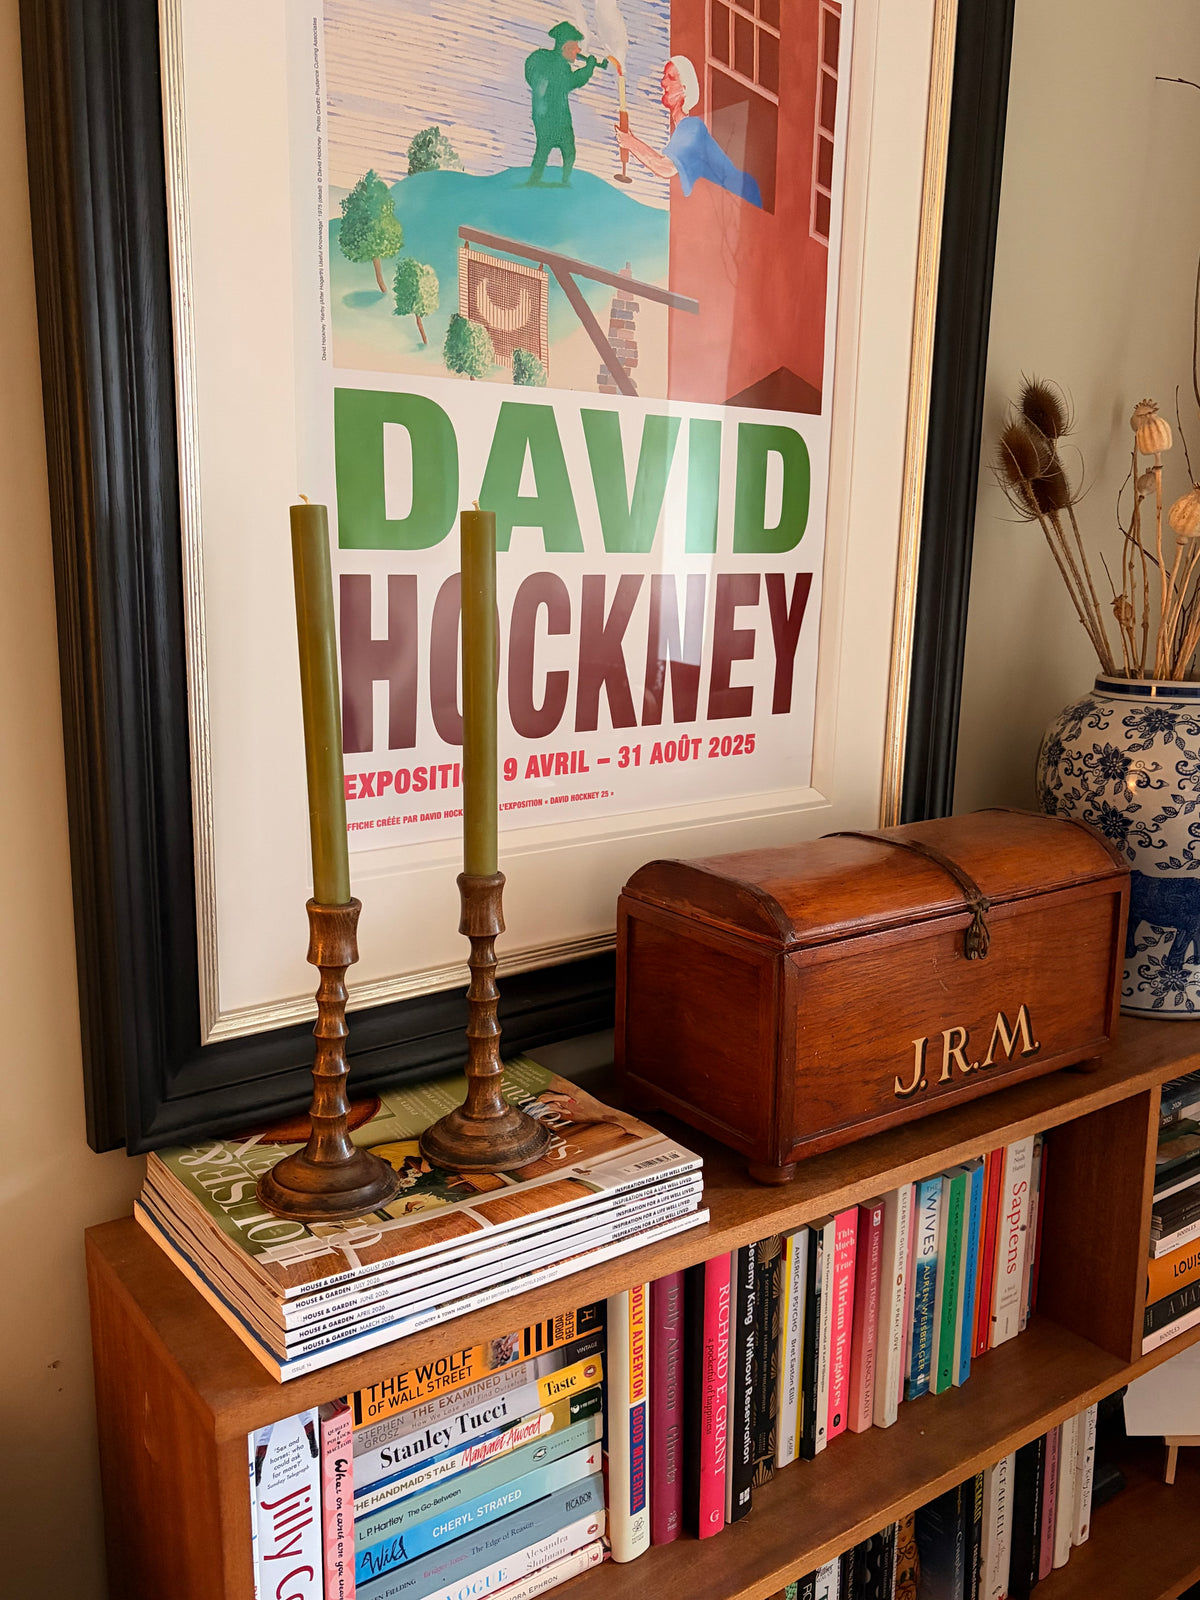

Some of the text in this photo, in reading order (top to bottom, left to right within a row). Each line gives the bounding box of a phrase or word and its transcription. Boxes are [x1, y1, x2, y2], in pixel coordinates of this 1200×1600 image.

[334, 386, 811, 555] DAVID
[339, 572, 814, 754] HOCKNEY
[344, 733, 757, 801] EXPOSITI 9 AVRIL – 31 AOÛT 2025
[347, 808, 464, 832] FFICHE CRÉÉE PAR DAVID HOCK
[498, 789, 609, 812] L'EXPOSITION DAVID HOCKNEY 25
[614, 1180, 646, 1194] INSPIRATION
[836, 1238, 854, 1251] Much
[837, 1228, 854, 1240] This
[922, 1192, 938, 1256] WIVES
[1006, 1180, 1027, 1276] Sapiens
[300, 1281, 322, 1293] HOUSE
[330, 1272, 356, 1284] GARDEN
[358, 1264, 380, 1276] AUGUST
[381, 1259, 396, 1269] 2026
[792, 1246, 800, 1295] AMERICAN
[836, 1260, 853, 1272] True
[892, 1192, 908, 1352] ELIZABETH GILBERT LOVE
[296, 1296, 318, 1309] HOUSE
[325, 1286, 352, 1299] GARDEN
[366, 1277, 380, 1286] 2026
[414, 1316, 436, 1328] COUNTRY
[442, 1309, 456, 1318] TOWN
[456, 1303, 472, 1312] HOUSE
[663, 1285, 680, 1330] Dolly
[790, 1296, 799, 1333] PSYCHO
[576, 1341, 598, 1354] VINTAGE
[632, 1284, 644, 1400] DOLLY ALDERTON
[834, 1275, 849, 1407] Miriam Margolyes
[862, 1232, 880, 1420] UNDER THE TUSCAN SUN FRANCES MAYES
[916, 1304, 930, 1371] WEISBERGER
[367, 1347, 473, 1403] THE WOLF
[667, 1338, 680, 1410] Alderton
[742, 1242, 758, 1465] Jeremy King Without Reservation
[368, 1365, 473, 1417] OF WALL STREET
[412, 1364, 528, 1420] THE EXAMINED LIFE
[704, 1344, 714, 1436] pocketful of happiness
[714, 1283, 730, 1476] RICHARD E. GRANT
[358, 1416, 405, 1444] STEPHEN
[364, 1428, 400, 1449] GROSZ
[380, 1375, 577, 1470] Stanley Tucci Taste
[460, 1415, 542, 1470] Margaret Atwood
[270, 1444, 304, 1465] horses: who
[274, 1437, 300, 1454] "Sex and
[274, 1454, 302, 1471] could ask
[632, 1406, 644, 1512] GOOD MATERIAL
[267, 1464, 310, 1490] Sunday Telegraph
[272, 1470, 282, 1480] for
[334, 1458, 349, 1495] What
[371, 1460, 456, 1505] HANDMAID'S TALE
[260, 1484, 314, 1561] Jilly
[335, 1497, 343, 1510] on
[374, 1488, 462, 1534] Hartley The Go-Between
[432, 1488, 522, 1538] CHERYL STRAYED
[336, 1513, 346, 1540] earth
[385, 1579, 417, 1598] FIELDING
[472, 1546, 484, 1556] The
[485, 1538, 502, 1550] Edge
[502, 1532, 510, 1541] of
[510, 1521, 535, 1537] Reason
[565, 1491, 593, 1512] PICADOR
[526, 1534, 569, 1560] Alexandra
[336, 1562, 344, 1578] you
[360, 1535, 408, 1575] Wild
[526, 1548, 566, 1571] Shulman
[528, 1575, 558, 1595] EPHRON
